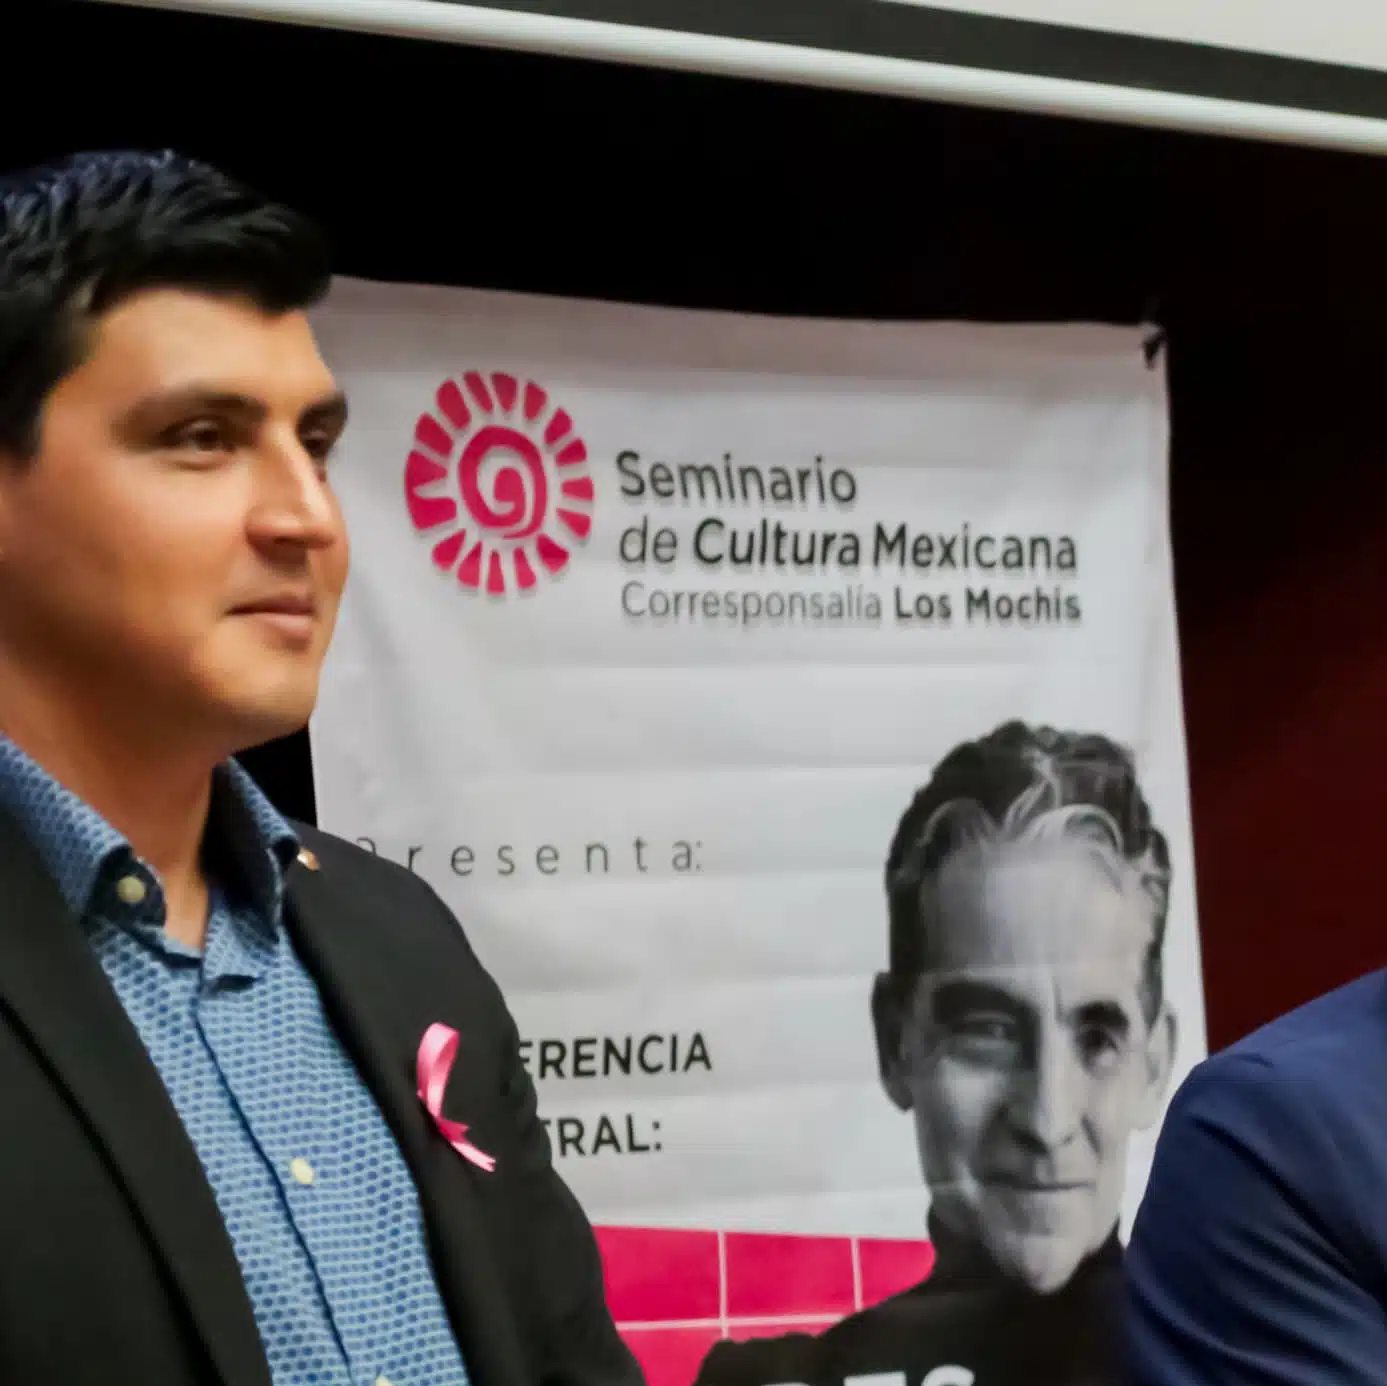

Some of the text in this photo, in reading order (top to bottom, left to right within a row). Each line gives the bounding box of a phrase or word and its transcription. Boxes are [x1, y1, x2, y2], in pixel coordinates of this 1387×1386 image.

[615, 450, 858, 507] Seminario
[619, 515, 1077, 571] de Cultura Mexicana
[620, 580, 1081, 629] Corresponsalía Los Mochis
